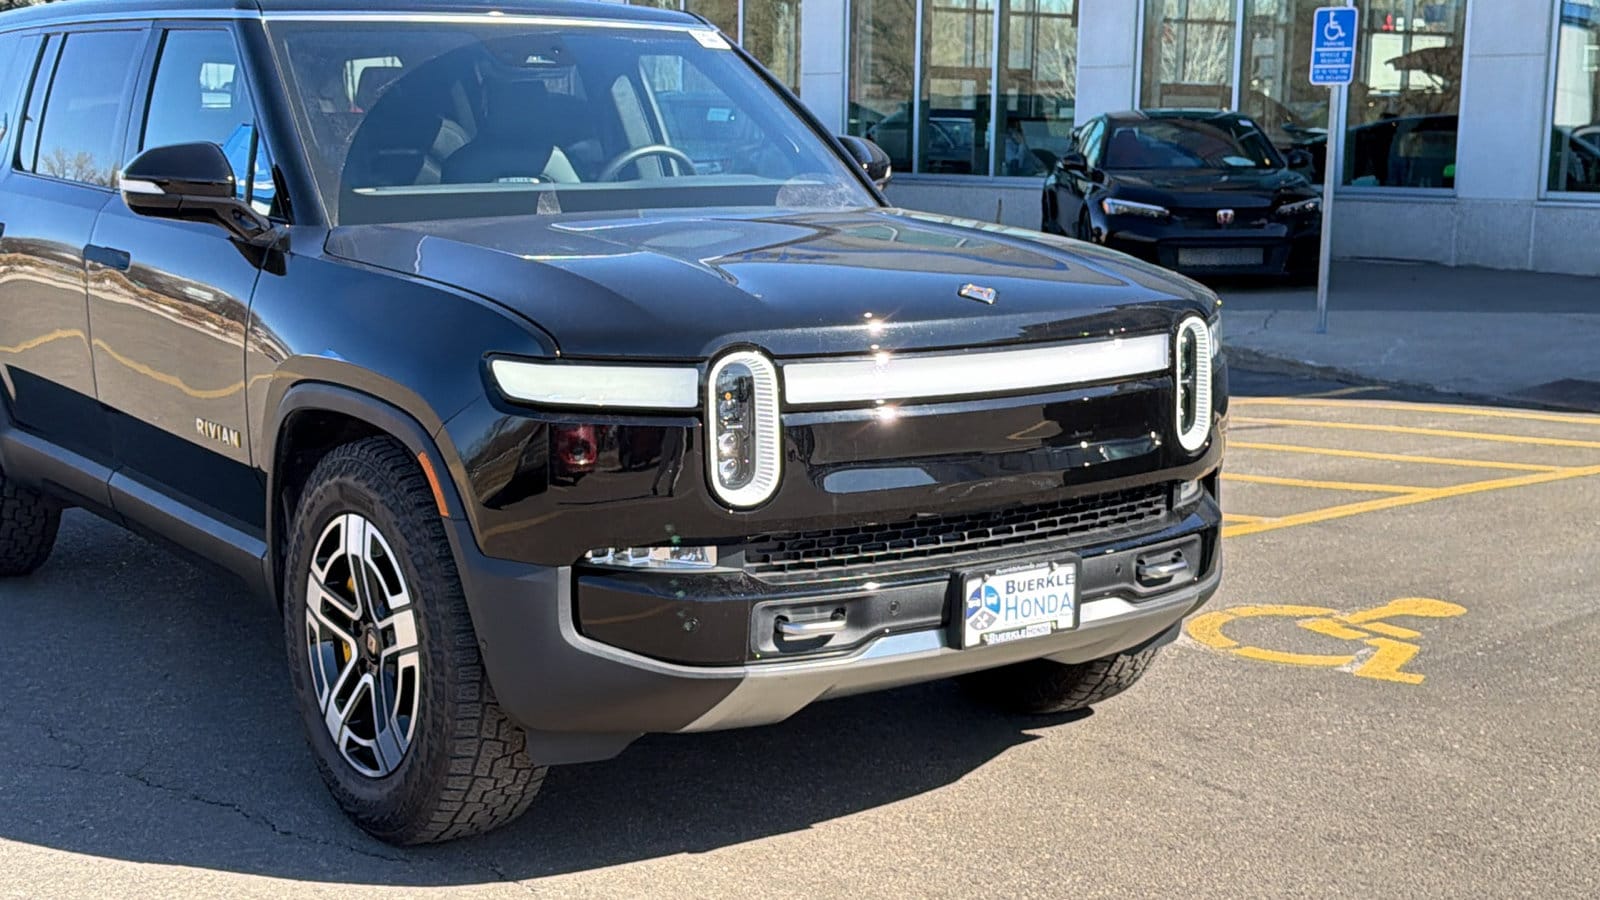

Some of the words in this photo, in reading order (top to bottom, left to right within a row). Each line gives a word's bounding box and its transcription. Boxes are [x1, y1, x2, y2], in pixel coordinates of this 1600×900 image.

[195, 417, 241, 449] RIVIAN
[1006, 573, 1075, 594] BUERKLE
[1005, 592, 1074, 621] HONDA
